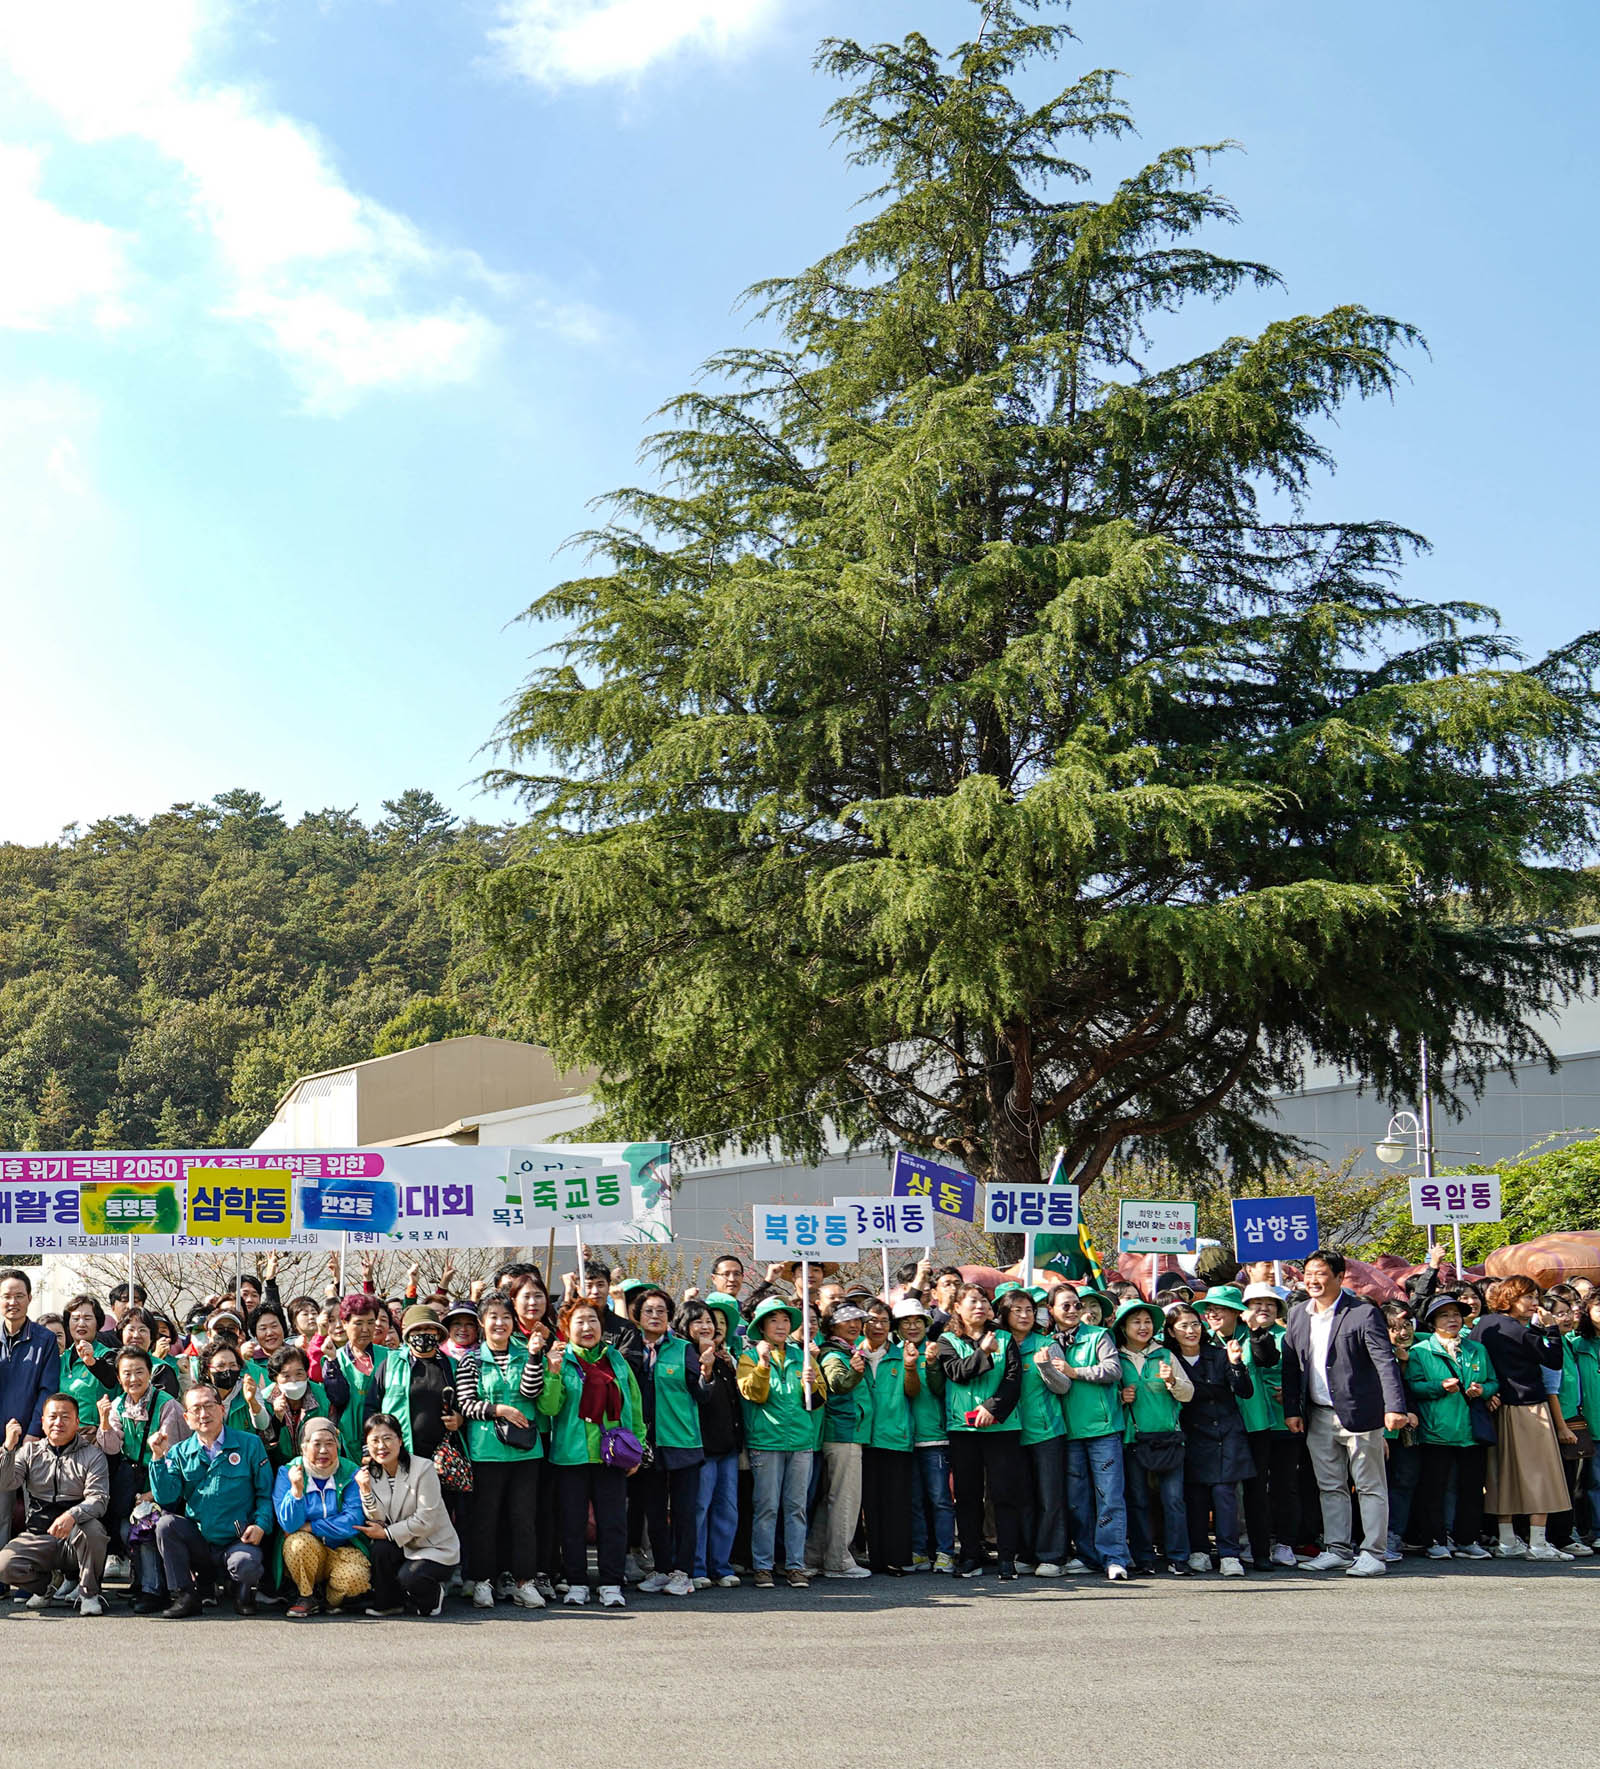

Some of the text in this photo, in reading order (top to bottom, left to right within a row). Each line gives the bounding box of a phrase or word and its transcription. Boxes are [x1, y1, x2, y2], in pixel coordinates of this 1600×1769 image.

[28, 1159, 68, 1180] 위기
[72, 1158, 118, 1179] 극복!
[123, 1158, 178, 1179] 2050
[326, 1154, 366, 1176] 위한
[191, 1186, 287, 1225] 삼학동
[321, 1195, 374, 1216] 만호동
[398, 1184, 474, 1218] 대회
[532, 1173, 621, 1212] 죽교동
[1420, 1182, 1492, 1211] 옥암동
[105, 1199, 158, 1218] 동명동
[991, 1190, 1074, 1227] 하당동
[34, 1236, 58, 1248] 장소
[408, 1231, 449, 1242] 목포시
[764, 1213, 849, 1247] 북항동
[1242, 1213, 1312, 1245] 삼향동
